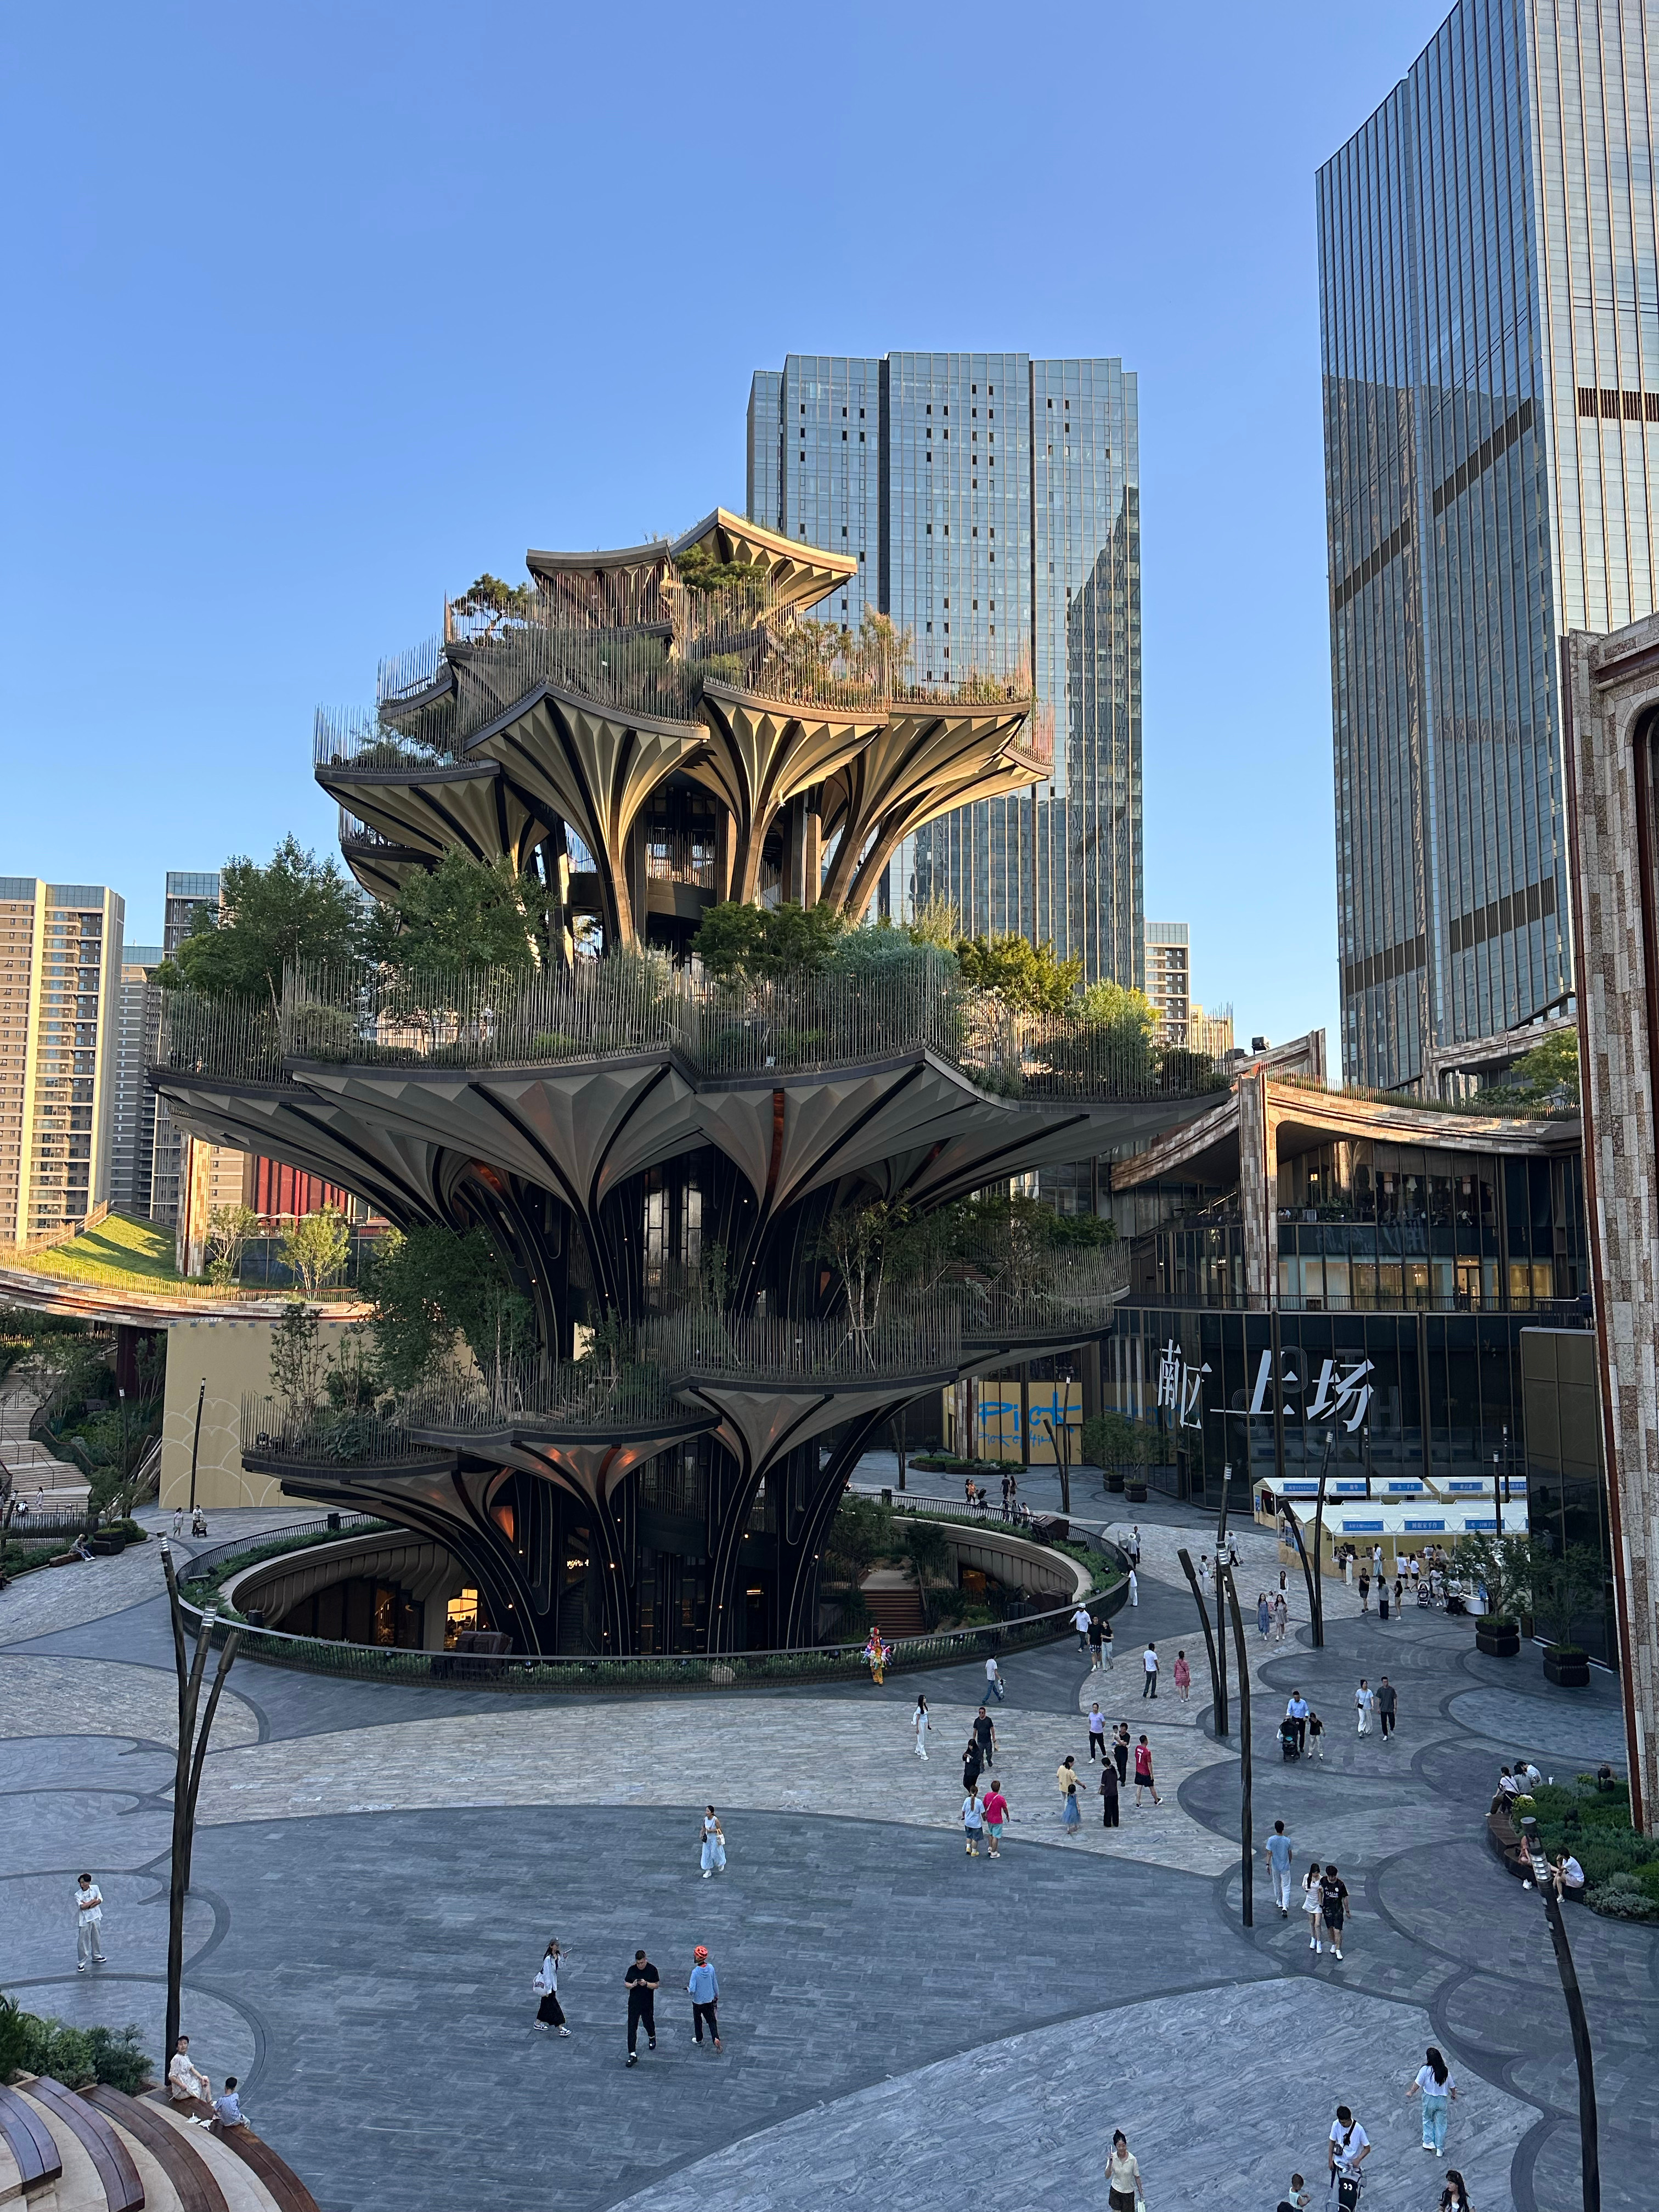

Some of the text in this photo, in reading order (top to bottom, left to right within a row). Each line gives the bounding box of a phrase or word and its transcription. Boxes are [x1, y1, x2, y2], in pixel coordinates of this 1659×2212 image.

[1158, 1339, 1375, 1432] 南区上场
[1137, 1752, 1142, 1763] 7
